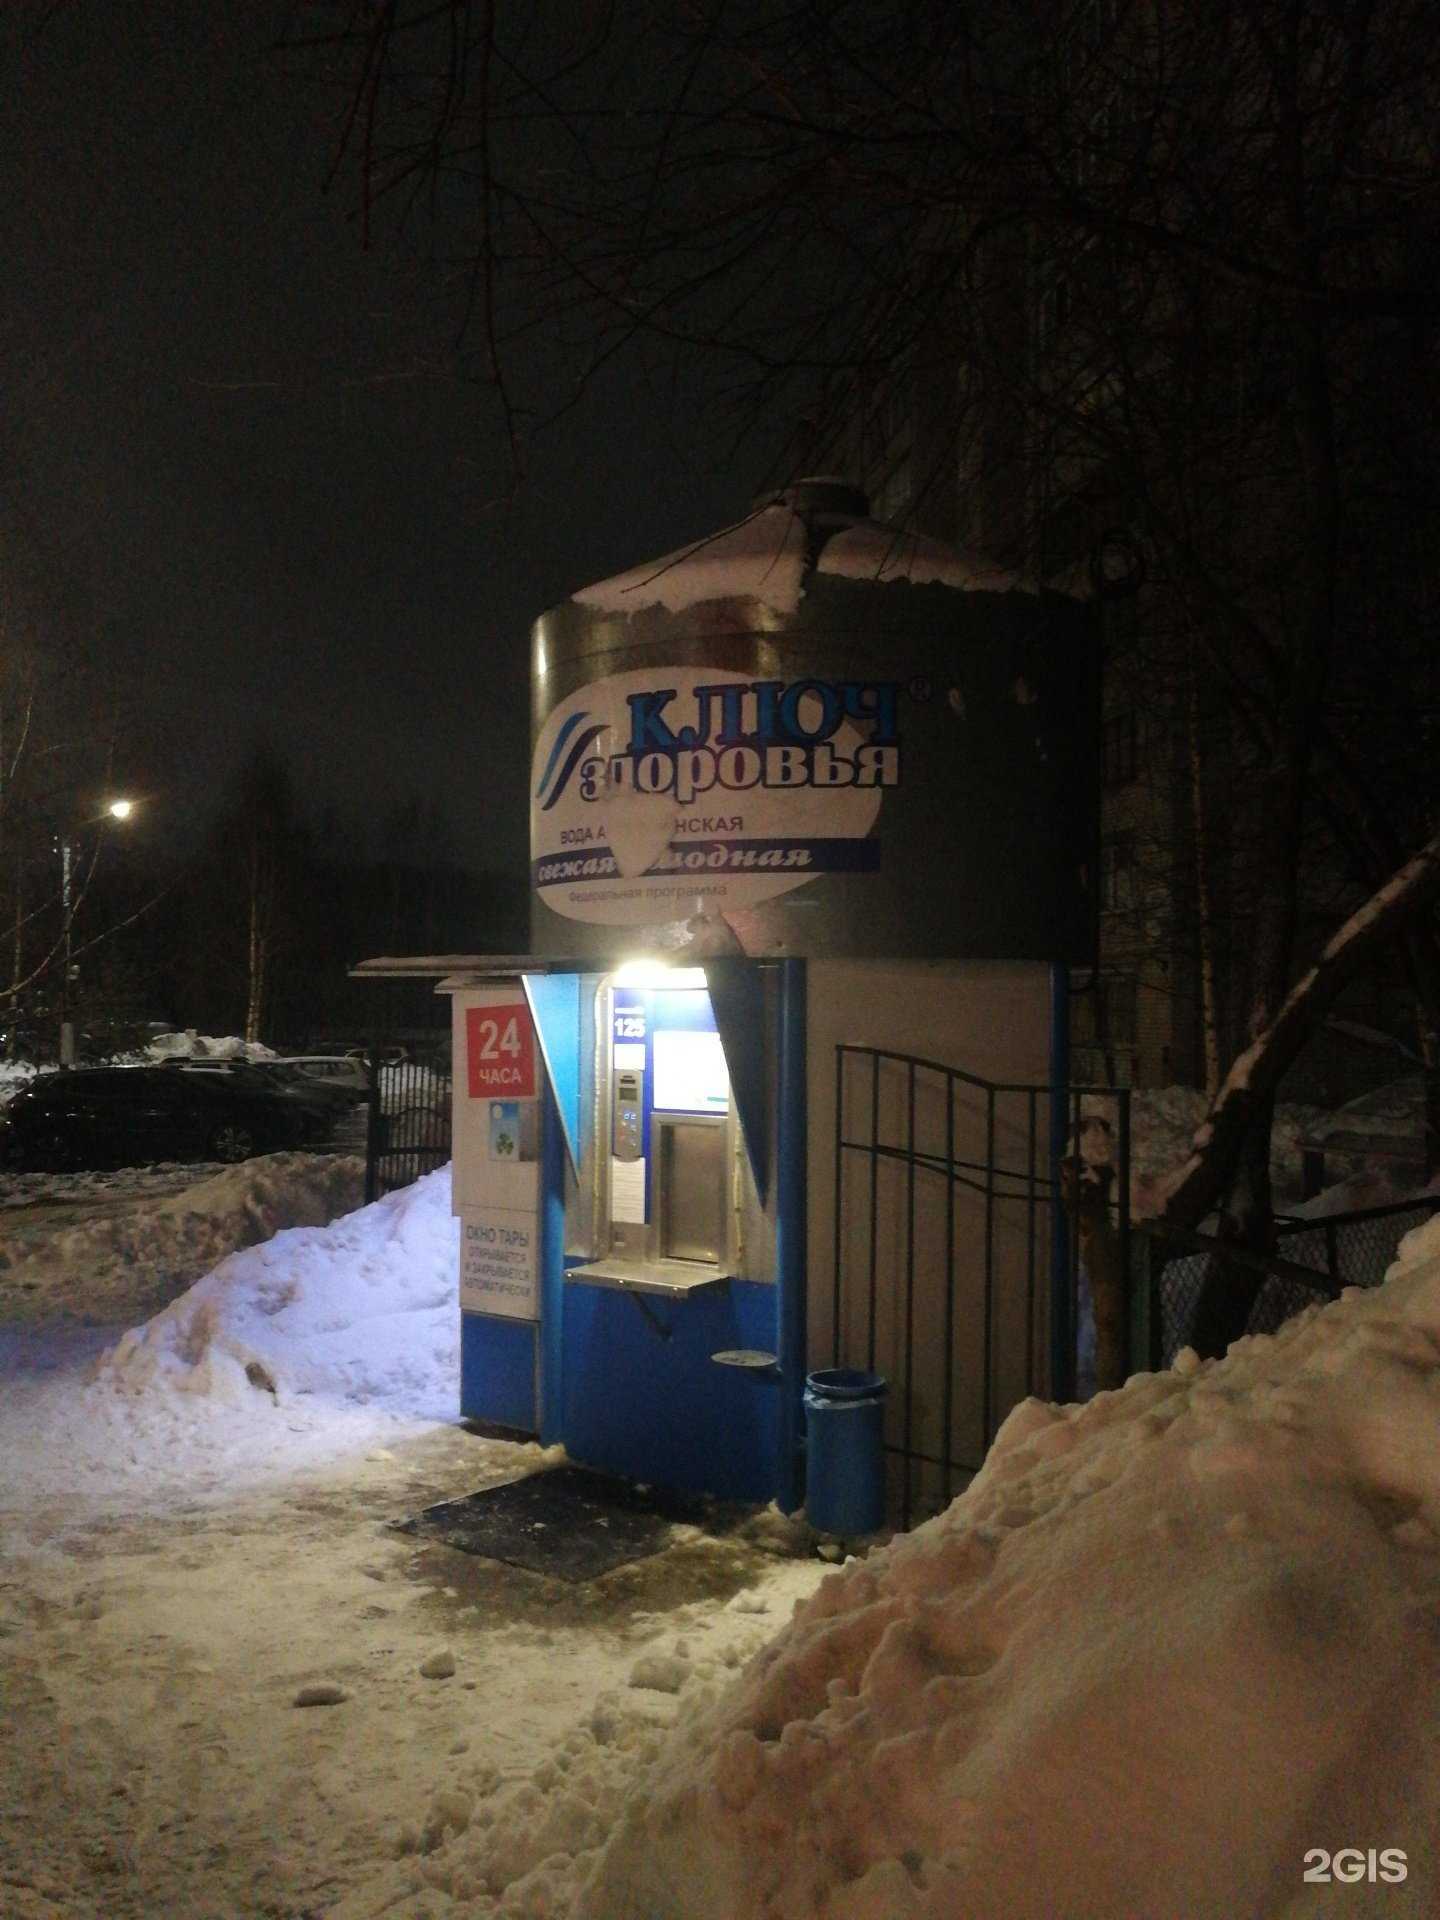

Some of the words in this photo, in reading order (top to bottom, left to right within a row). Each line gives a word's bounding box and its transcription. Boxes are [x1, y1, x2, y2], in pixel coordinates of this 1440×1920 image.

[560, 827, 592, 846] ВОДА
[479, 1016, 521, 1060] 24
[479, 1067, 522, 1085] ЧАСА
[466, 1225, 497, 1242] ОКНО
[499, 1228, 529, 1247] ТАРЫ
